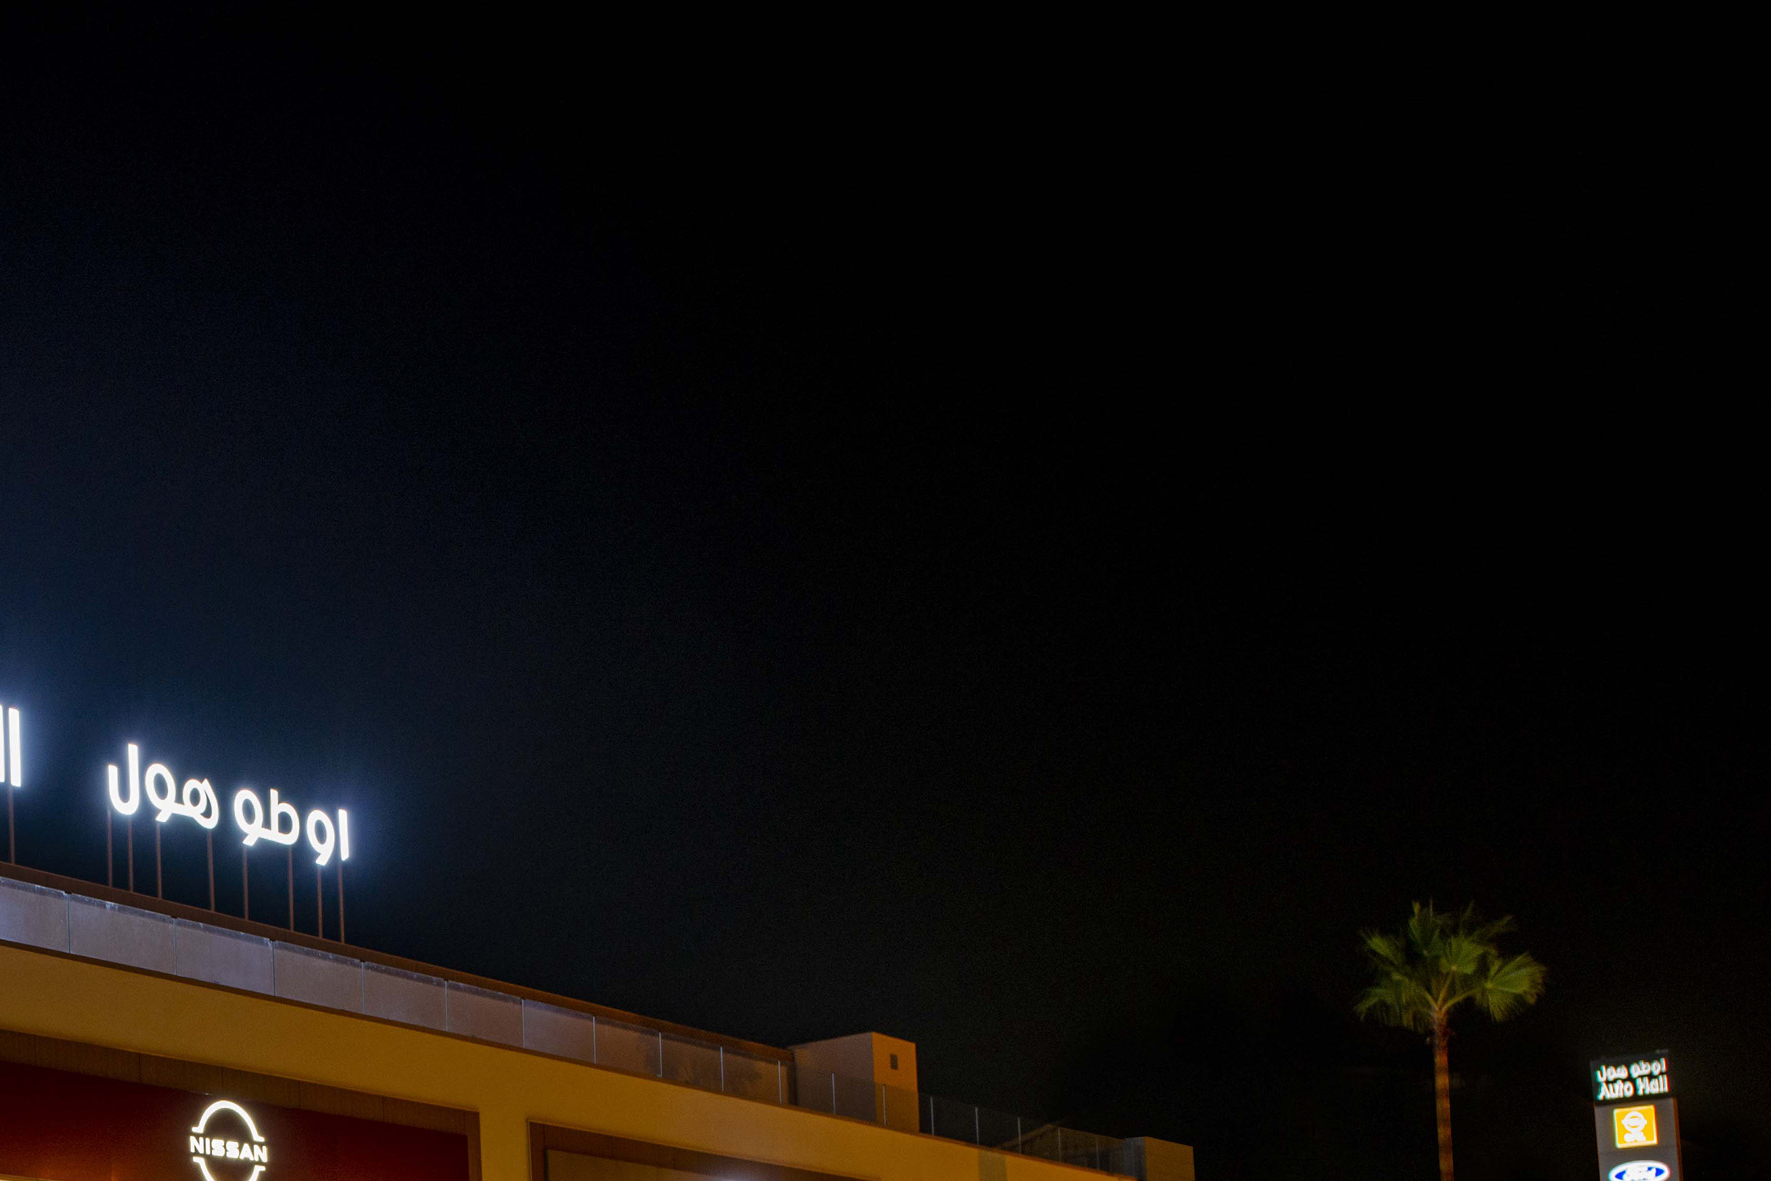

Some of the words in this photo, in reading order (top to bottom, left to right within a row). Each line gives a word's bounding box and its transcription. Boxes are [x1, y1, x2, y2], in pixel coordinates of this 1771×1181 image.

[107, 743, 220, 829] هول
[1597, 1080, 1634, 1100] Auto
[1636, 1074, 1670, 1096] Hall
[189, 1135, 268, 1163] NISSAN
